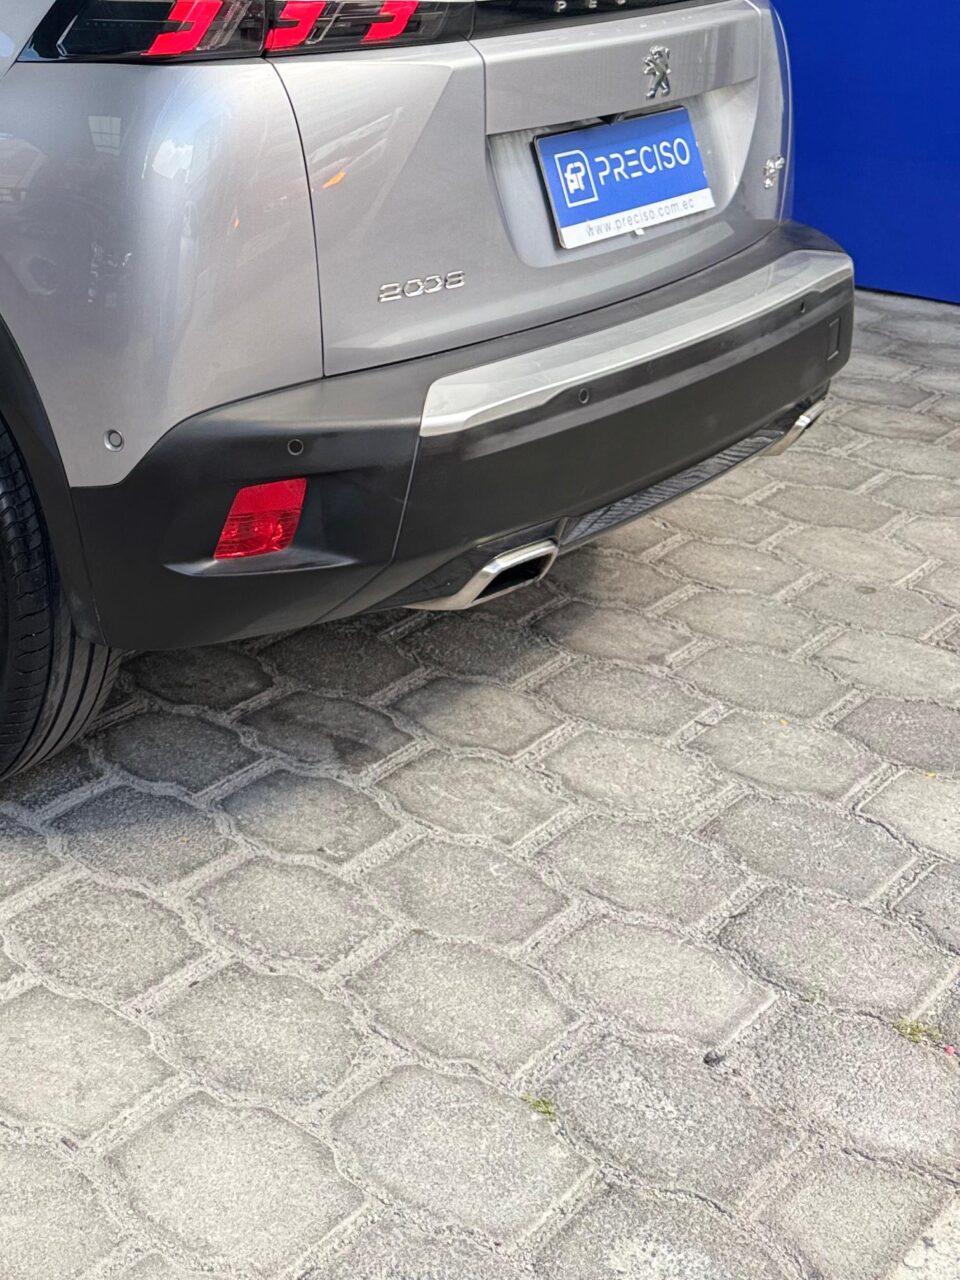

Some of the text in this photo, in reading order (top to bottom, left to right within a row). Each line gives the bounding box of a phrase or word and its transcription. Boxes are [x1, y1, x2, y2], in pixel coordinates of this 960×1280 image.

[594, 137, 691, 186] PRECISO
[586, 198, 695, 237] www.preciso.com.ec
[378, 270, 465, 303] 2008
